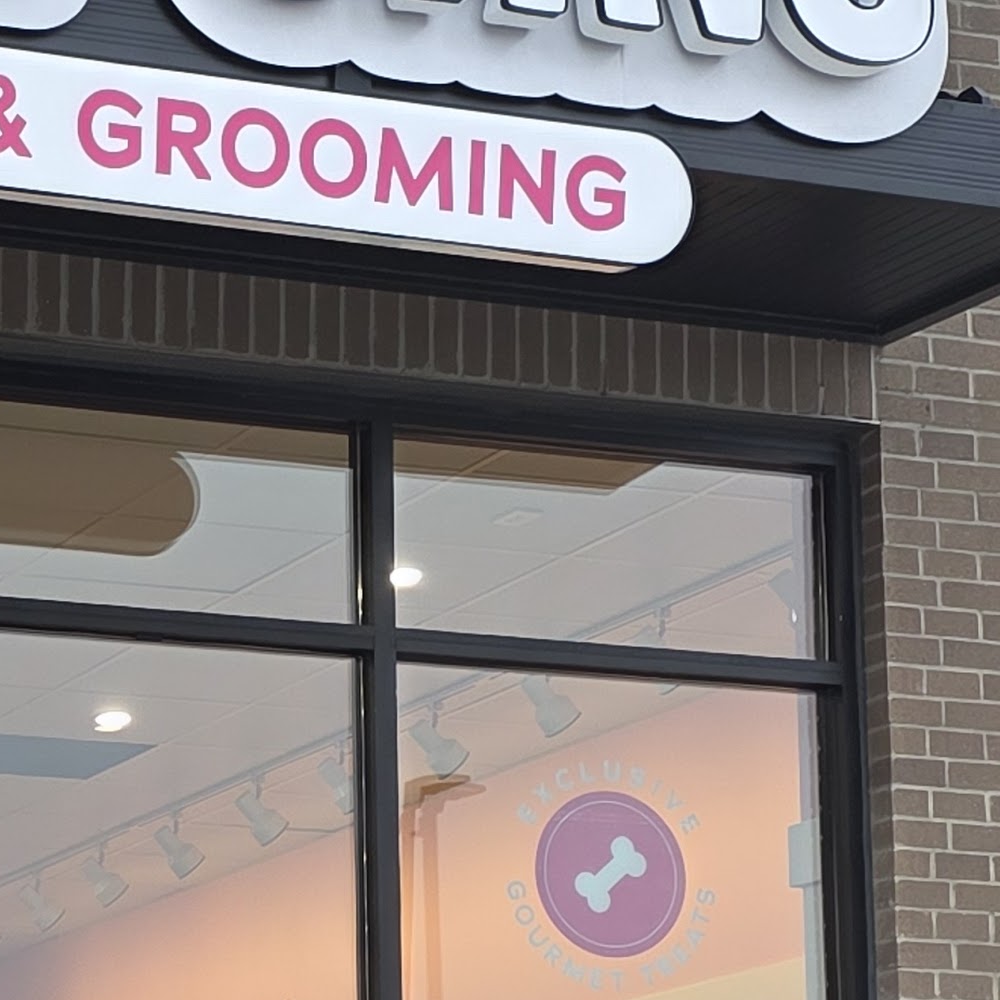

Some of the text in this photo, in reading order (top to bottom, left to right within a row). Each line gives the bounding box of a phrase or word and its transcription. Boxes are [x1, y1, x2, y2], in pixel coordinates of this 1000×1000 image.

[77, 88, 627, 232] GROOMING
[516, 760, 700, 835] EXCLUSIVE
[506, 880, 717, 992] GOURMET TREATS
